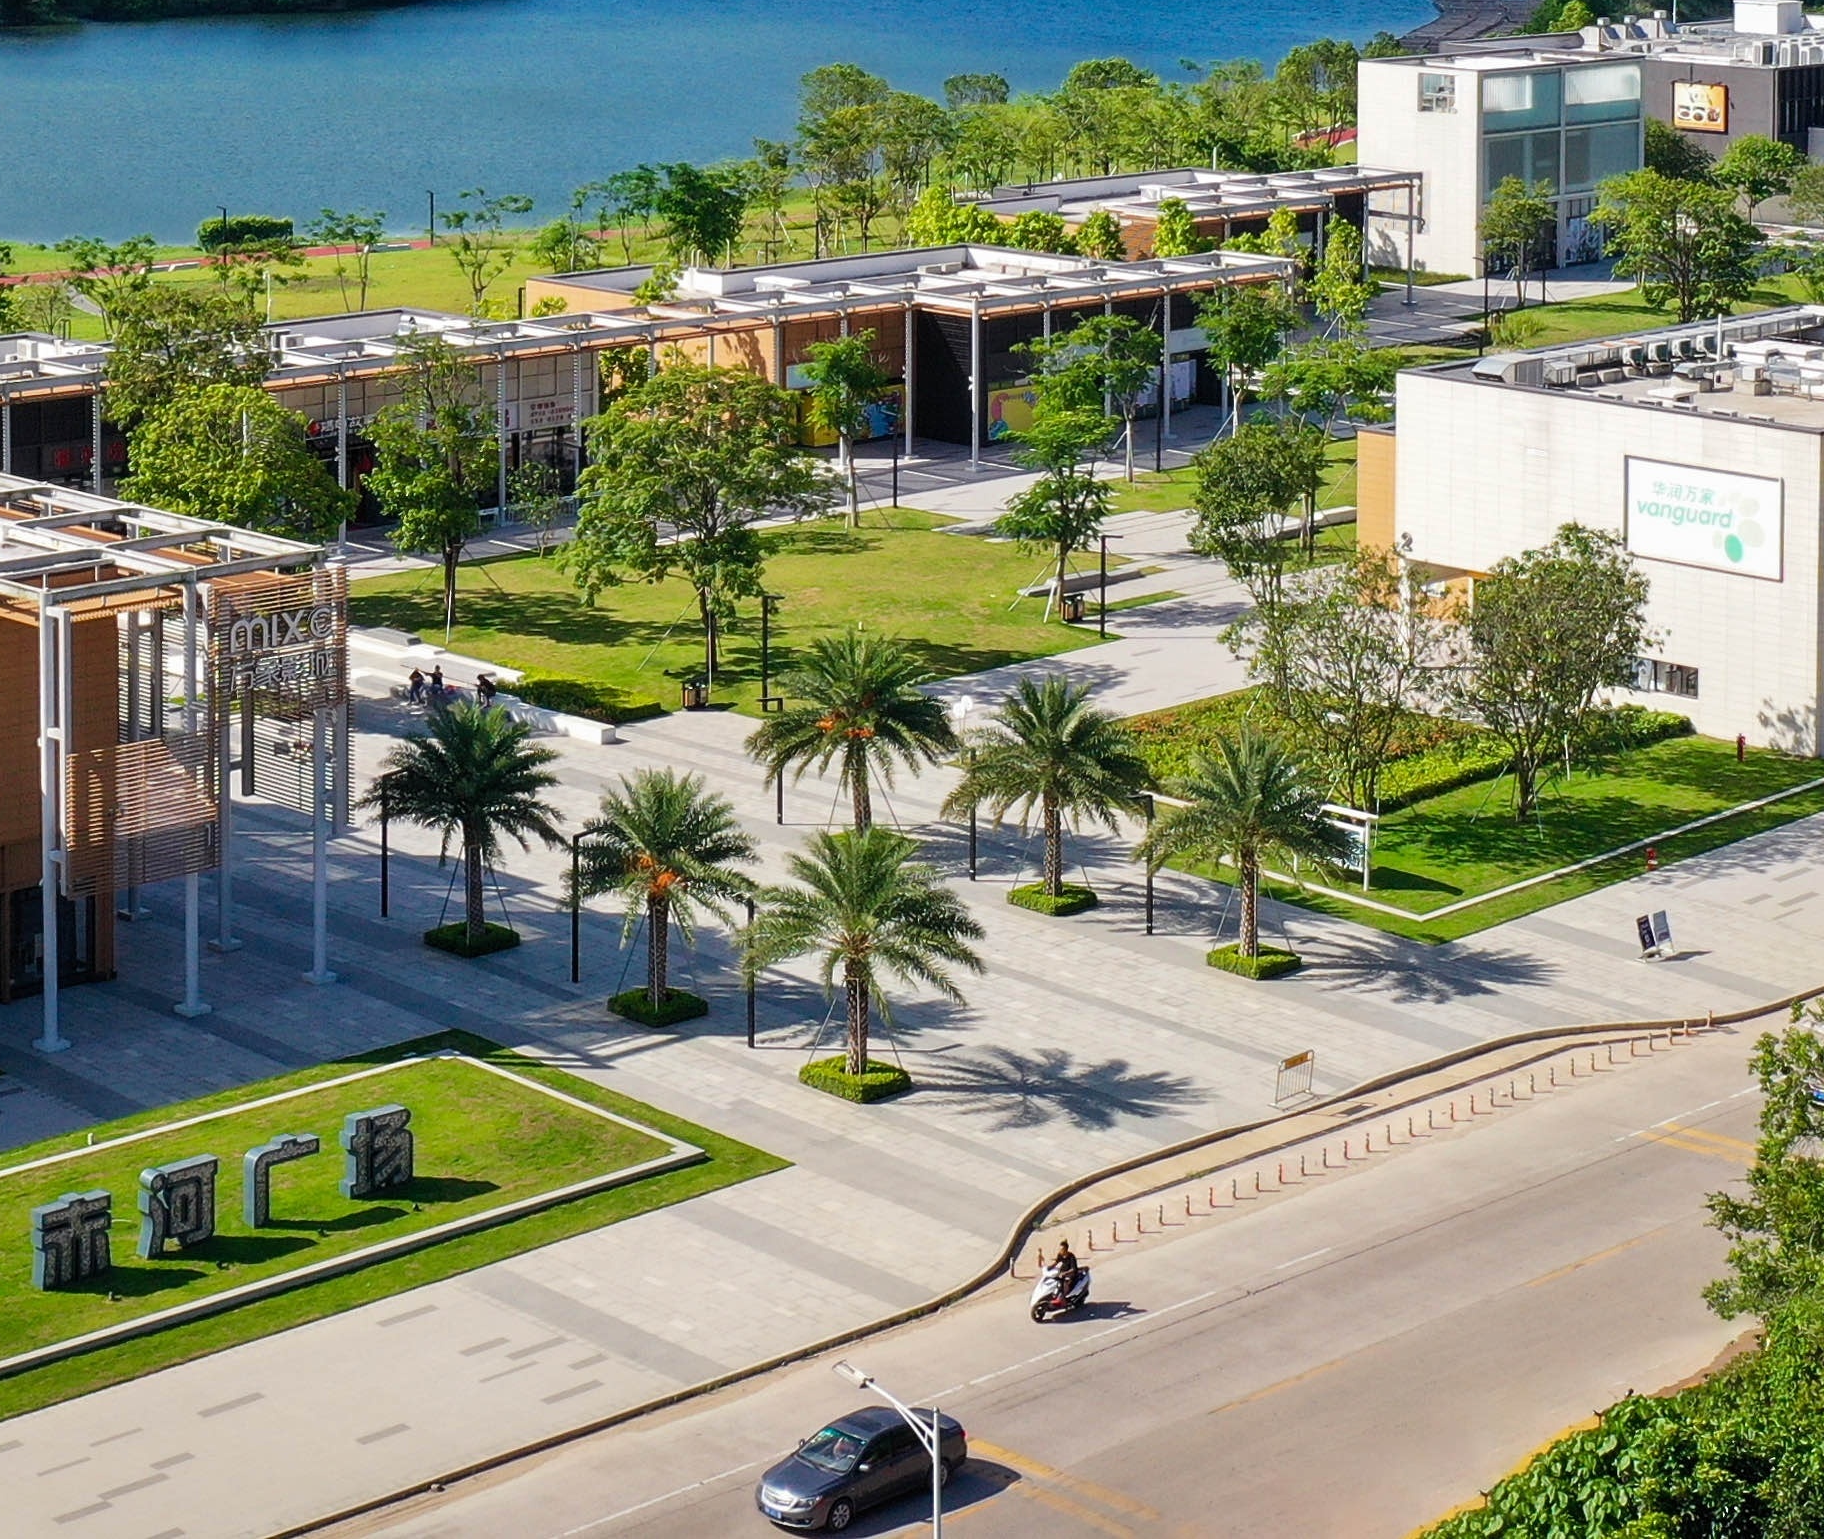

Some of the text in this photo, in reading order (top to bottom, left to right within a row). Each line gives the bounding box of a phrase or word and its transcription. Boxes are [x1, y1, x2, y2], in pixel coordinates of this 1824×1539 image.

[1652, 480, 1715, 506] 华润万家
[1636, 497, 1733, 529] vanguard
[1401, 531, 1413, 552] 2
